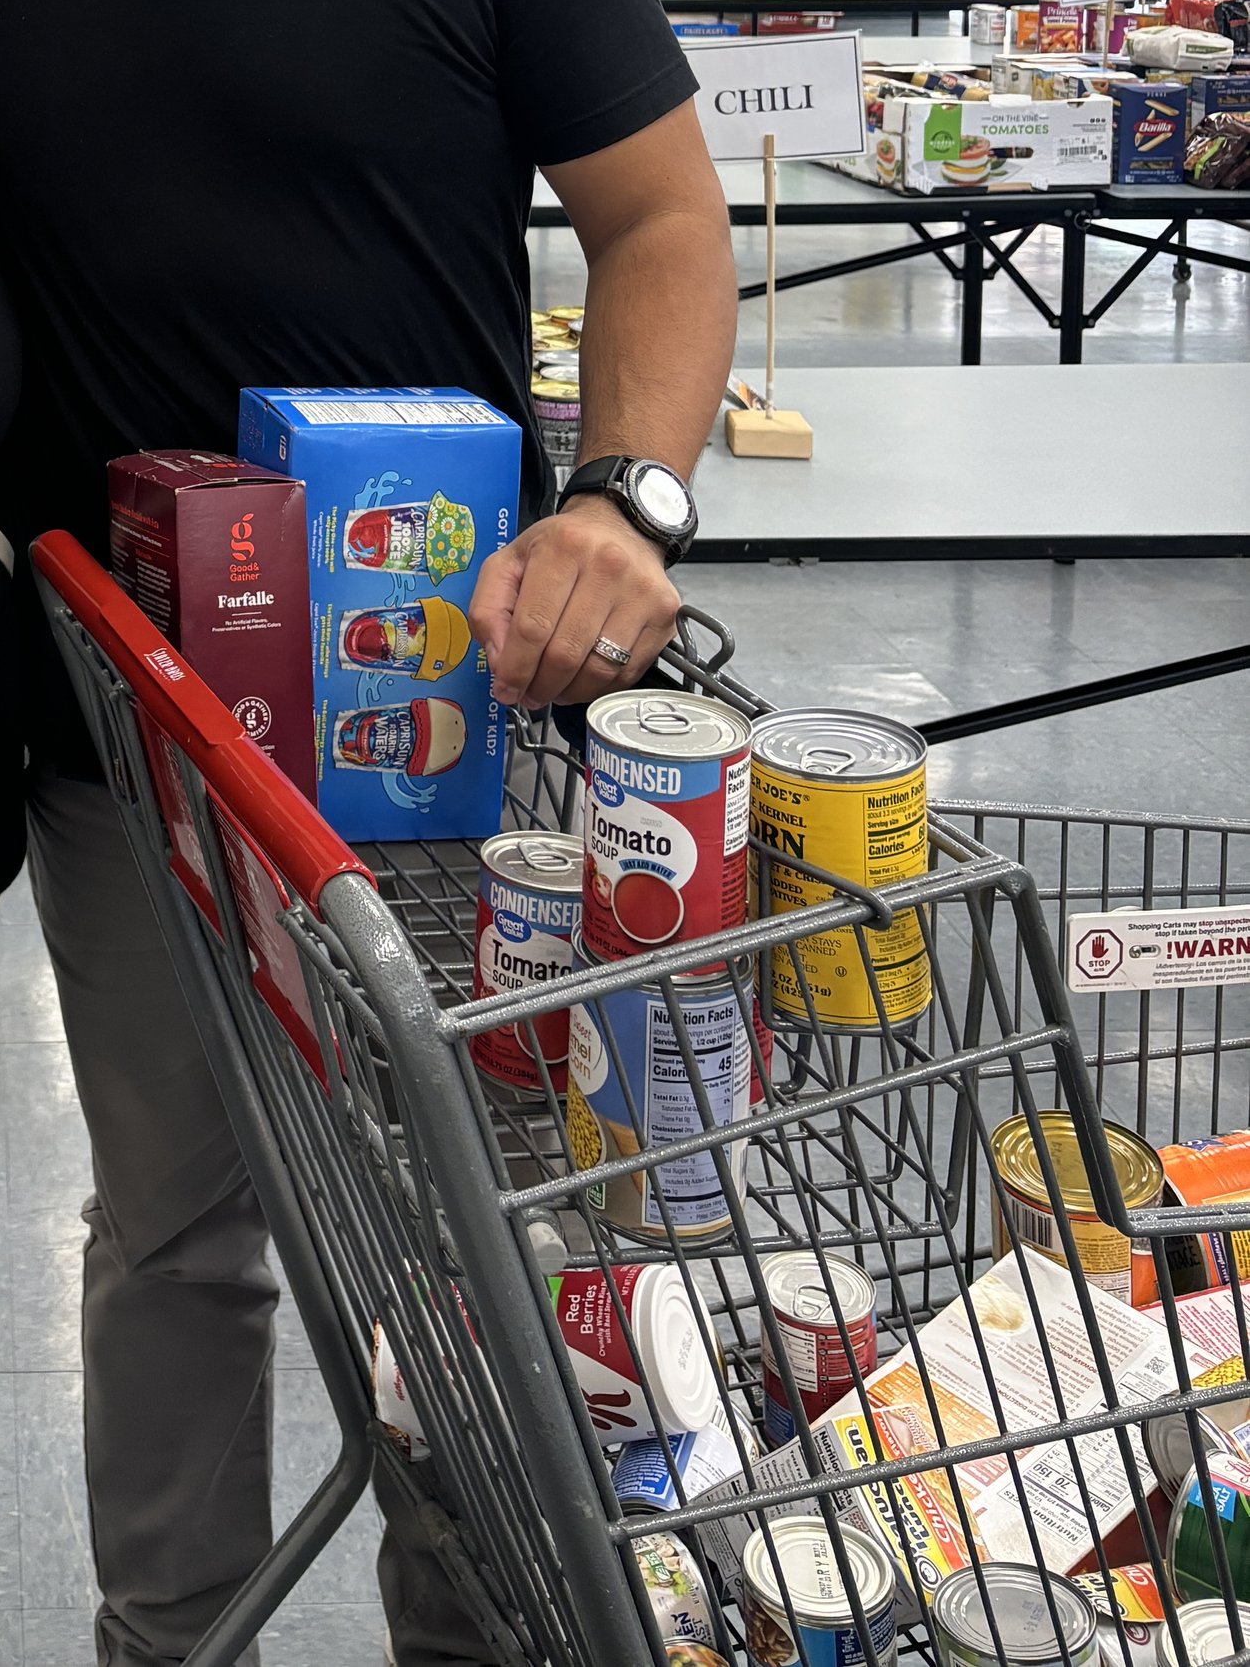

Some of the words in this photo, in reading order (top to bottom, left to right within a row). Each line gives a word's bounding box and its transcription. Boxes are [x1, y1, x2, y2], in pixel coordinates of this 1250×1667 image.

[714, 84, 815, 117] CHILI
[1006, 114, 1019, 122] THE
[1020, 114, 1039, 122] VINE
[981, 124, 1049, 135] TOMATOES
[1138, 122, 1172, 133] Barilla
[497, 508, 509, 538] GOT
[390, 513, 398, 561] JUICE
[400, 521, 412, 558] 100%
[230, 572, 260, 582] Gather
[217, 590, 275, 609] Farfalle
[232, 618, 251, 626] Artificial
[246, 623, 267, 632] Synthetic
[488, 703, 499, 721] OF
[373, 716, 389, 761] WATERS
[486, 725, 498, 757] KID?
[589, 739, 681, 795] CONDENSED
[594, 773, 618, 795] Great
[728, 779, 745, 795] Facts
[599, 789, 618, 804] Value
[867, 791, 910, 809] Nutrition
[911, 782, 925, 797] Facts
[759, 802, 807, 829] KERNEL
[868, 820, 888, 829] Serving
[889, 818, 899, 826] size
[591, 802, 672, 857] Tomato
[868, 836, 888, 844] Amount
[868, 839, 905, 856] Calories
[591, 837, 619, 861] SOUP
[623, 860, 637, 869] JUST
[637, 860, 649, 870] ADD
[649, 861, 672, 878] WATER
[497, 913, 524, 933] Great
[502, 924, 524, 939] Value
[1128, 922, 1162, 931] Shopping
[1163, 921, 1182, 929] Carts
[1182, 921, 1198, 930] may
[1198, 920, 1214, 929] stop
[1155, 930, 1170, 938] stop
[1178, 929, 1198, 937] taken
[1198, 927, 1224, 937] beyond
[1225, 926, 1237, 934] the
[795, 941, 837, 957] CANNED
[810, 937, 842, 949] STAYS
[1088, 960, 1111, 969] STOP
[1223, 965, 1244, 975] puertas
[492, 969, 523, 990] SOUP
[778, 973, 792, 987] OZ
[1173, 976, 1199, 984] llevados
[1199, 974, 1216, 983] fuera
[1216, 972, 1226, 981] del
[707, 1006, 734, 1023] Facts
[653, 1028, 671, 1036] about
[704, 1029, 712, 1037] per
[653, 1037, 678, 1047] Serving
[696, 1037, 706, 1046] 1/2
[706, 1037, 717, 1046] cup
[718, 1055, 732, 1072] 45
[652, 1124, 684, 1133] Cholesterol
[672, 1167, 689, 1175] Sugars
[566, 1294, 581, 1322] Red
[580, 1284, 598, 1334] Berries
[597, 1306, 605, 1327] Wheat
[902, 1407, 921, 1445] Ramen
[877, 1415, 901, 1456] Flavor
[815, 1436, 825, 1455] Serving
[788, 1450, 801, 1467] Total
[1033, 1461, 1053, 1480] 150
[1054, 1476, 1070, 1491] 70
[1216, 1487, 1230, 1513] SALT
[1032, 1507, 1079, 1544] Nutrition
